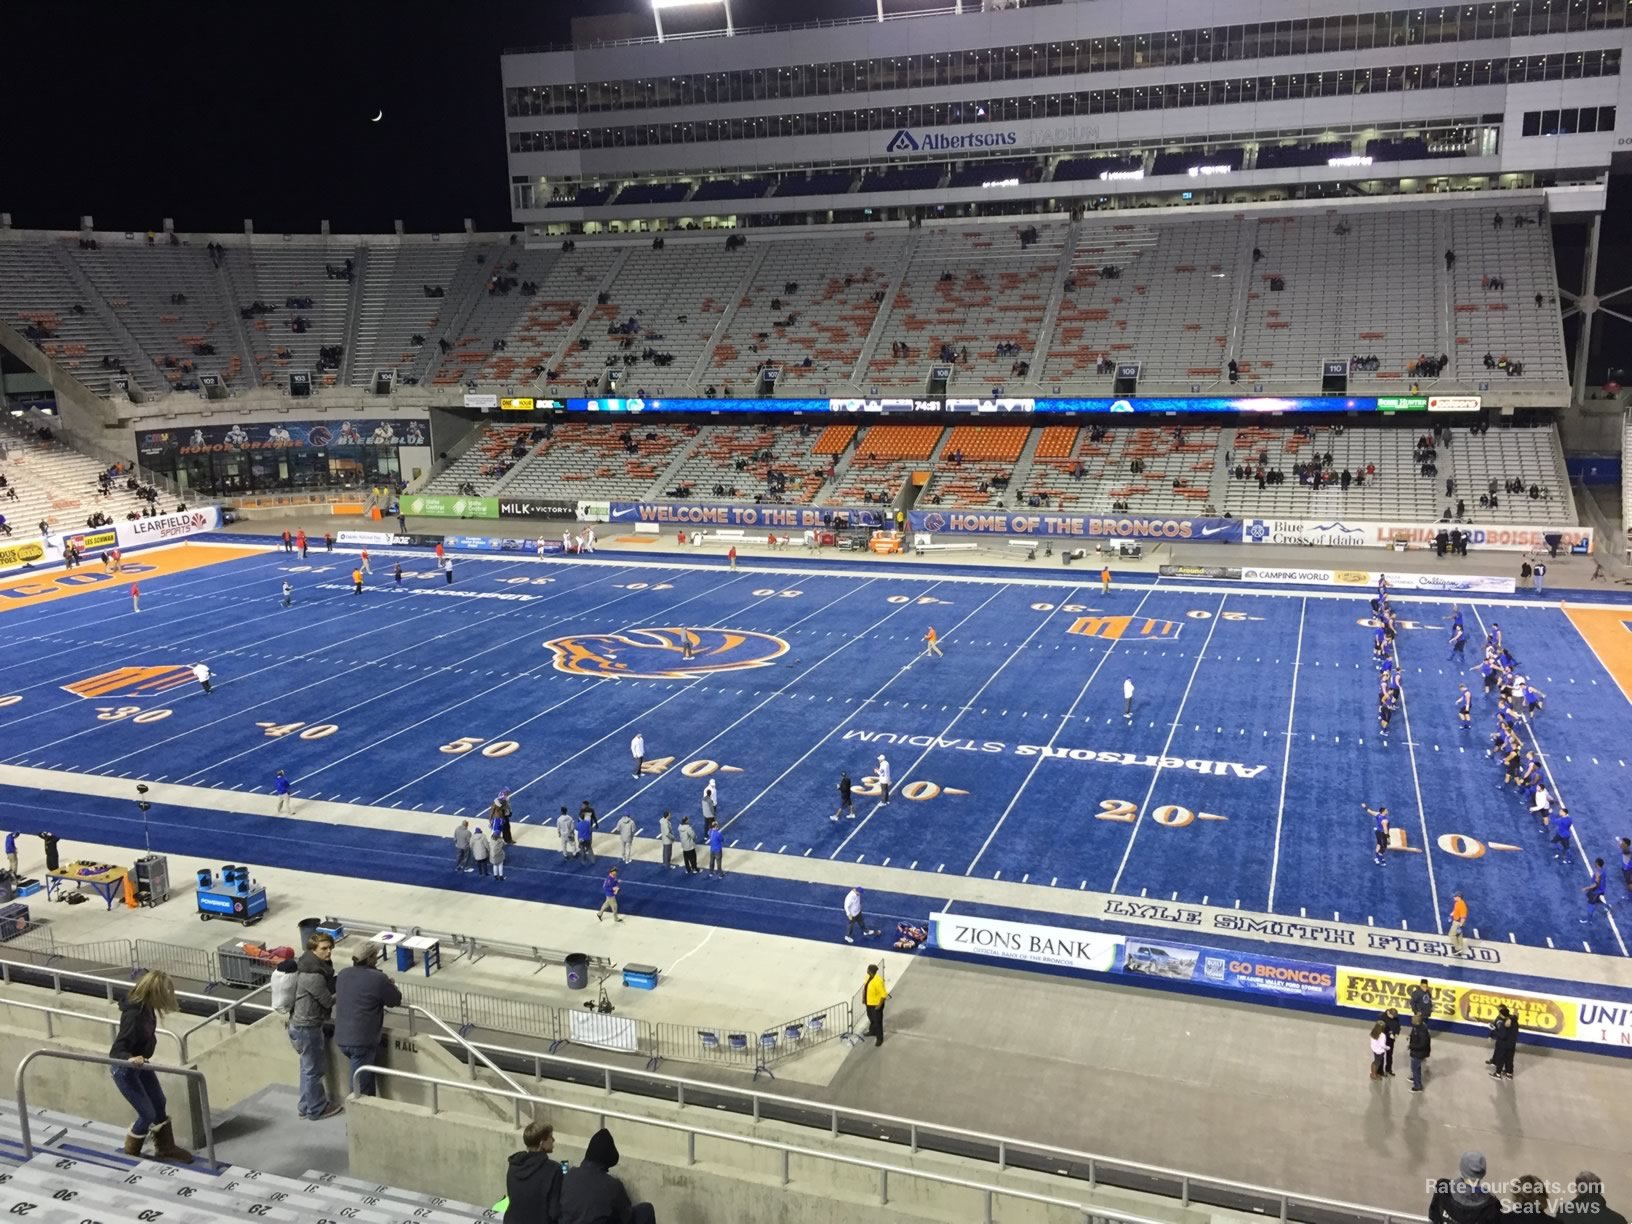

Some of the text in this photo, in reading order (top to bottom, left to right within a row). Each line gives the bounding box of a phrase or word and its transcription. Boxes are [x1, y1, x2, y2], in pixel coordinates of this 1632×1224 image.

[921, 130, 1017, 150] Albertsons
[1329, 365, 1342, 373] 110
[203, 377, 215, 385] 102
[501, 503, 531, 515] MILK
[640, 506, 728, 524] WELCOME
[732, 509, 758, 525] TO
[762, 509, 798, 526] THE
[133, 515, 191, 535] LEARFIELD
[950, 514, 1193, 538] HOME OF THE BRONCOS
[1274, 521, 1304, 532] Blue
[160, 525, 192, 538] SPORTS
[1273, 533, 1364, 546] Cross of Idaho
[1260, 571, 1297, 580] CAMPING
[1298, 572, 1330, 581] WORLD
[1419, 576, 1458, 589] Culligan
[408, 588, 544, 602] Albertsons
[752, 588, 805, 598] 50
[439, 736, 521, 758] 50
[842, 728, 1268, 780] Albertsons STADIUM
[1104, 899, 1202, 926] LYLE
[1213, 914, 1355, 946] SMITH
[954, 925, 1093, 961] ZIONS BANK
[972, 947, 1000, 956] OFFICIAL
[1042, 956, 1074, 966] BRONCOS
[1228, 960, 1332, 987] GO BRONCOS
[1264, 979, 1285, 987] VALLEY
[1285, 981, 1300, 989] FORD
[1301, 984, 1323, 993] STORES
[1469, 993, 1548, 1013] GROWN IN
[1468, 1003, 1558, 1029] IDHO
[394, 1040, 418, 1053] RAIL
[55, 1159, 77, 1170] 32
[160, 1166, 180, 1177] 32
[243, 1170, 262, 1180] 32
[319, 1173, 337, 1182] 32
[124, 1174, 142, 1185] 31
[177, 1186, 198, 1198] 30
[223, 1181, 240, 1191] 31
[303, 1184, 320, 1194] 31
[52, 1189, 79, 1201] 30
[270, 1192, 289, 1202] 30
[362, 1196, 381, 1207] 30
[431, 1197, 448, 1208] 30
[9, 1202, 38, 1216] 29
[248, 1203, 273, 1217] 29
[340, 1207, 361, 1219] 29
[413, 1207, 433, 1219] 29
[482, 1208, 499, 1219] 29
[137, 1209, 164, 1222] 29
